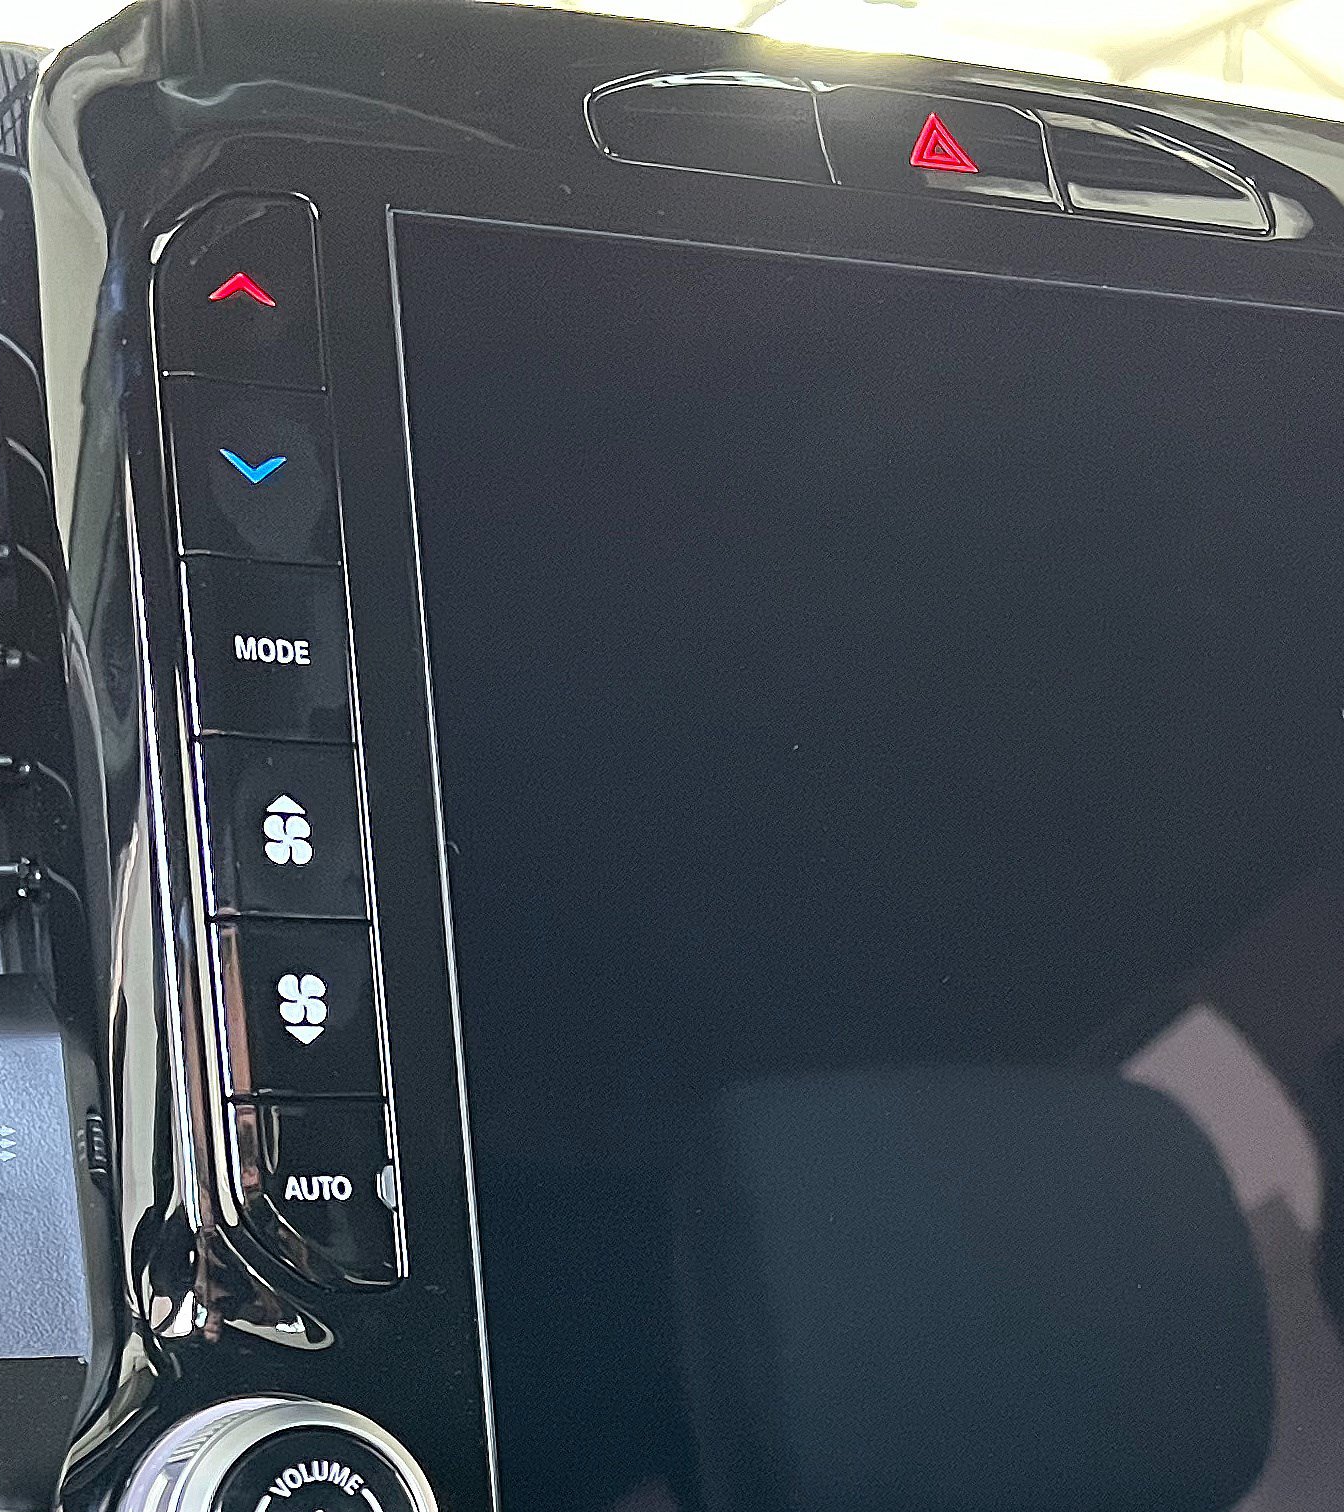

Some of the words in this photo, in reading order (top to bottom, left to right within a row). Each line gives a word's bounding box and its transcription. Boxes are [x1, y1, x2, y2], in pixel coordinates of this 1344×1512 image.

[234, 635, 312, 666] MODE
[283, 1175, 353, 1202] AUTO
[268, 1459, 365, 1499] VOLUME
